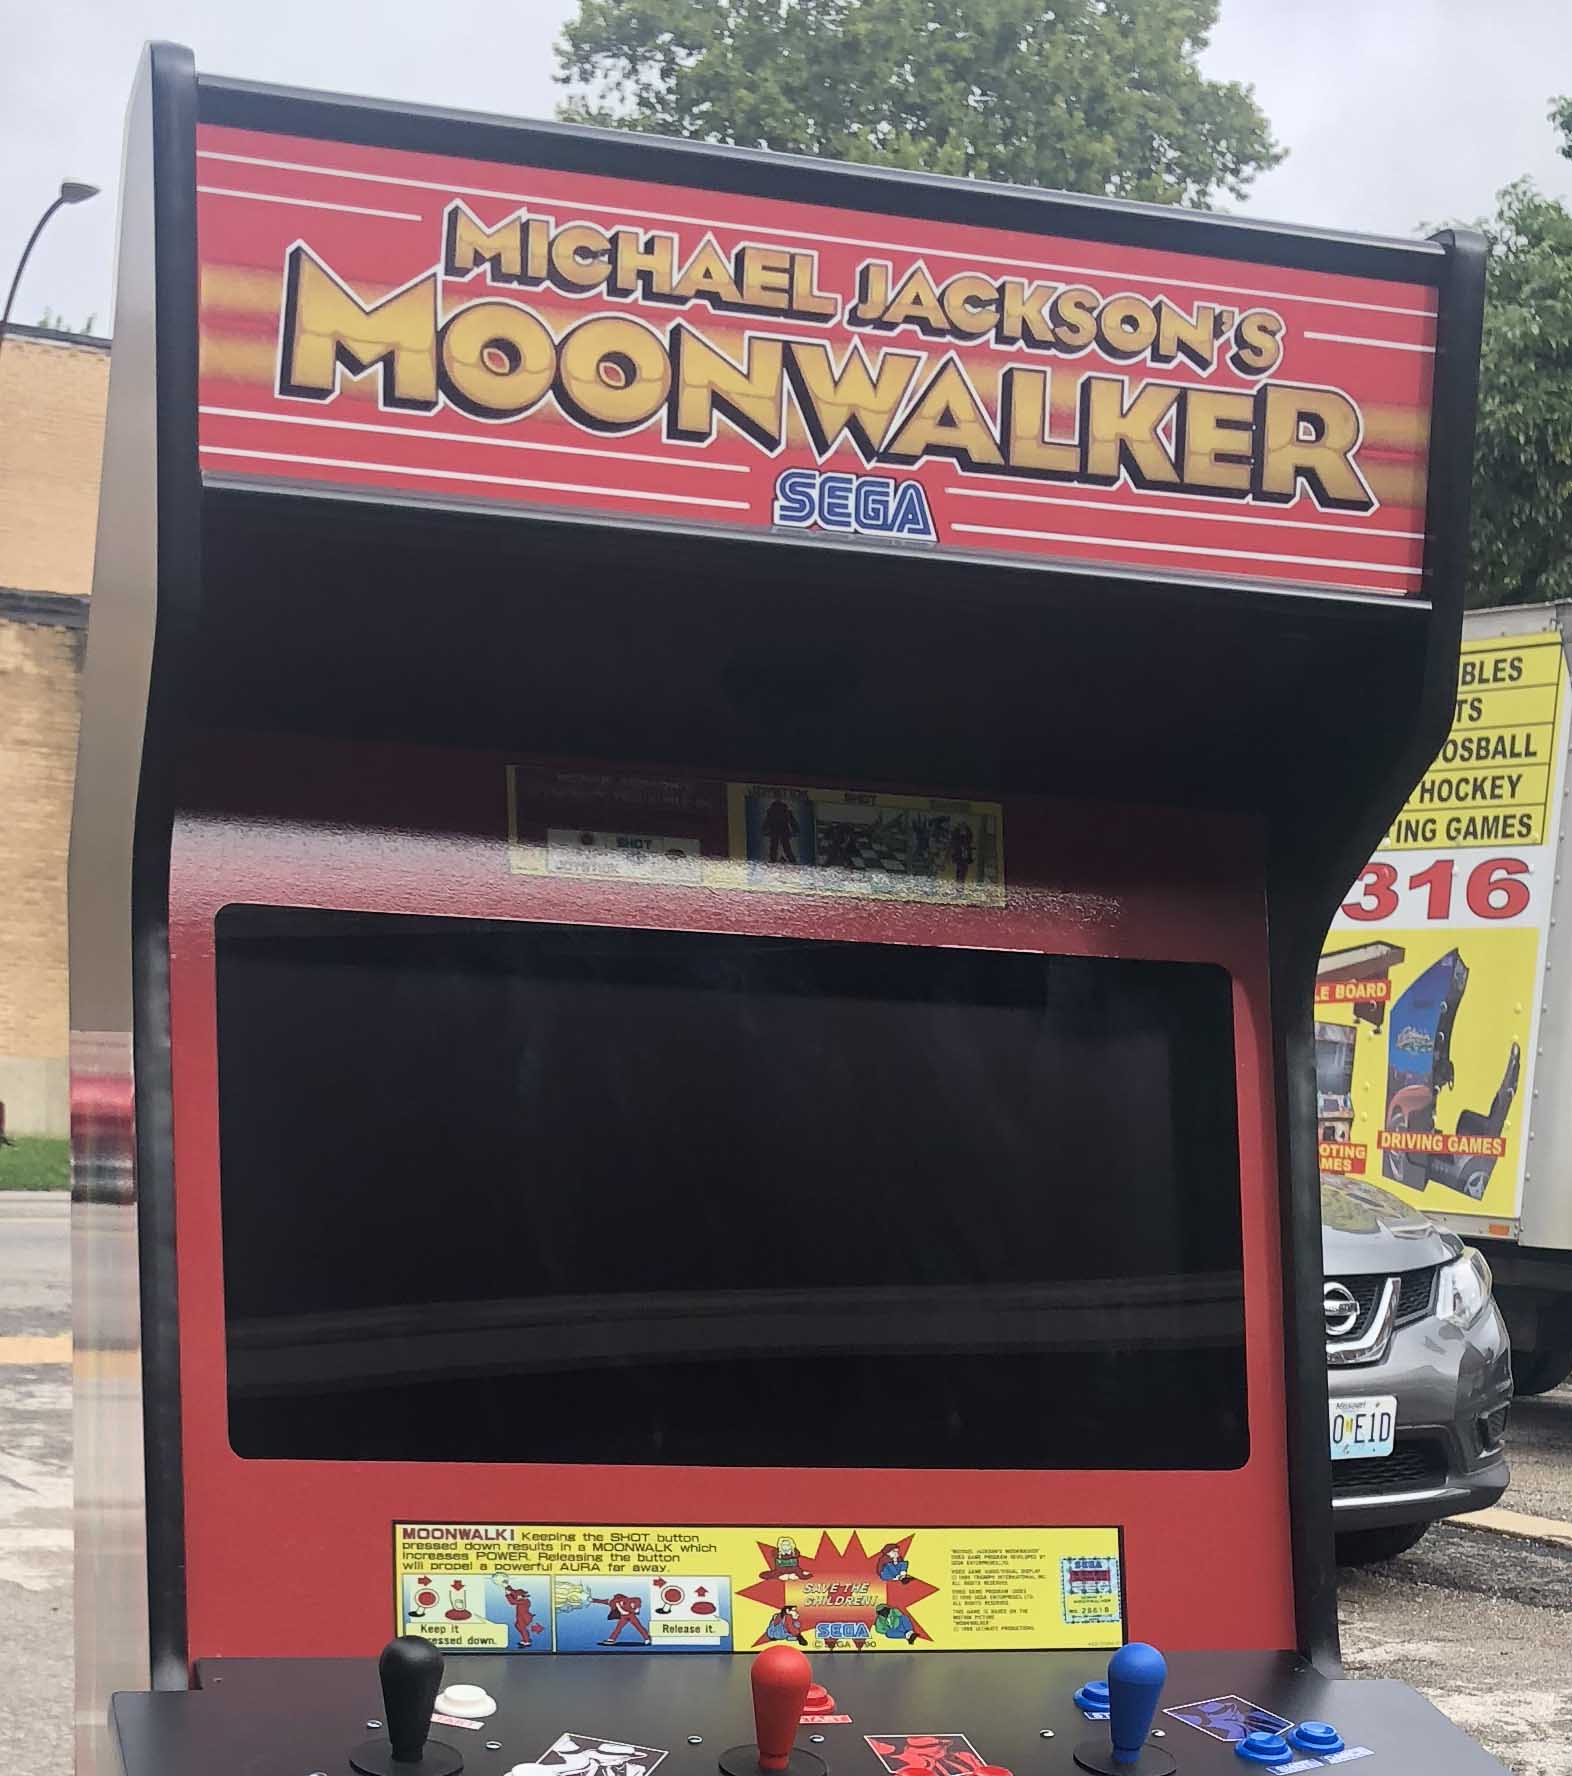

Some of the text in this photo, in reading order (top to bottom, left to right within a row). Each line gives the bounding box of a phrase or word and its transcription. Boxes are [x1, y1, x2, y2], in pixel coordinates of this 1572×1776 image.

[443, 199, 1285, 377] MICHAEL JACKSON'S
[276, 239, 1377, 516] MOONWALKER
[774, 469, 940, 541] SEGA
[1419, 774, 1522, 803] HOCKEY
[1446, 813, 1532, 841] GAMES
[1341, 858, 1530, 921] 316
[1335, 983, 1387, 999] BOARD
[1381, 1132, 1502, 1155] DRIVING GAMES
[1319, 1143, 1366, 1159] OTING
[1321, 1158, 1352, 1171] MES
[521, 1532, 576, 1543] Keeping
[582, 1533, 604, 1542] the
[610, 1533, 650, 1542] SHOT
[657, 1534, 699, 1543] button
[402, 1542, 457, 1551] pressed
[464, 1542, 500, 1550] down
[507, 1542, 553, 1551] results
[560, 1542, 571, 1551] in
[592, 1543, 673, 1552] MOONWALK
[680, 1544, 717, 1553] which
[402, 1551, 469, 1560] increases
[538, 1552, 603, 1563] Releasing
[610, 1554, 631, 1562] the
[637, 1554, 680, 1562] button
[402, 1562, 671, 1573] will propel a powerful AURA far away.
[803, 1583, 870, 1594] SAVE THE
[804, 1595, 879, 1607] CHILDREN!
[420, 1623, 460, 1634] Keep it
[662, 1623, 701, 1634] Release
[816, 1622, 871, 1639] SEGA
[428, 1636, 462, 1645] essed
